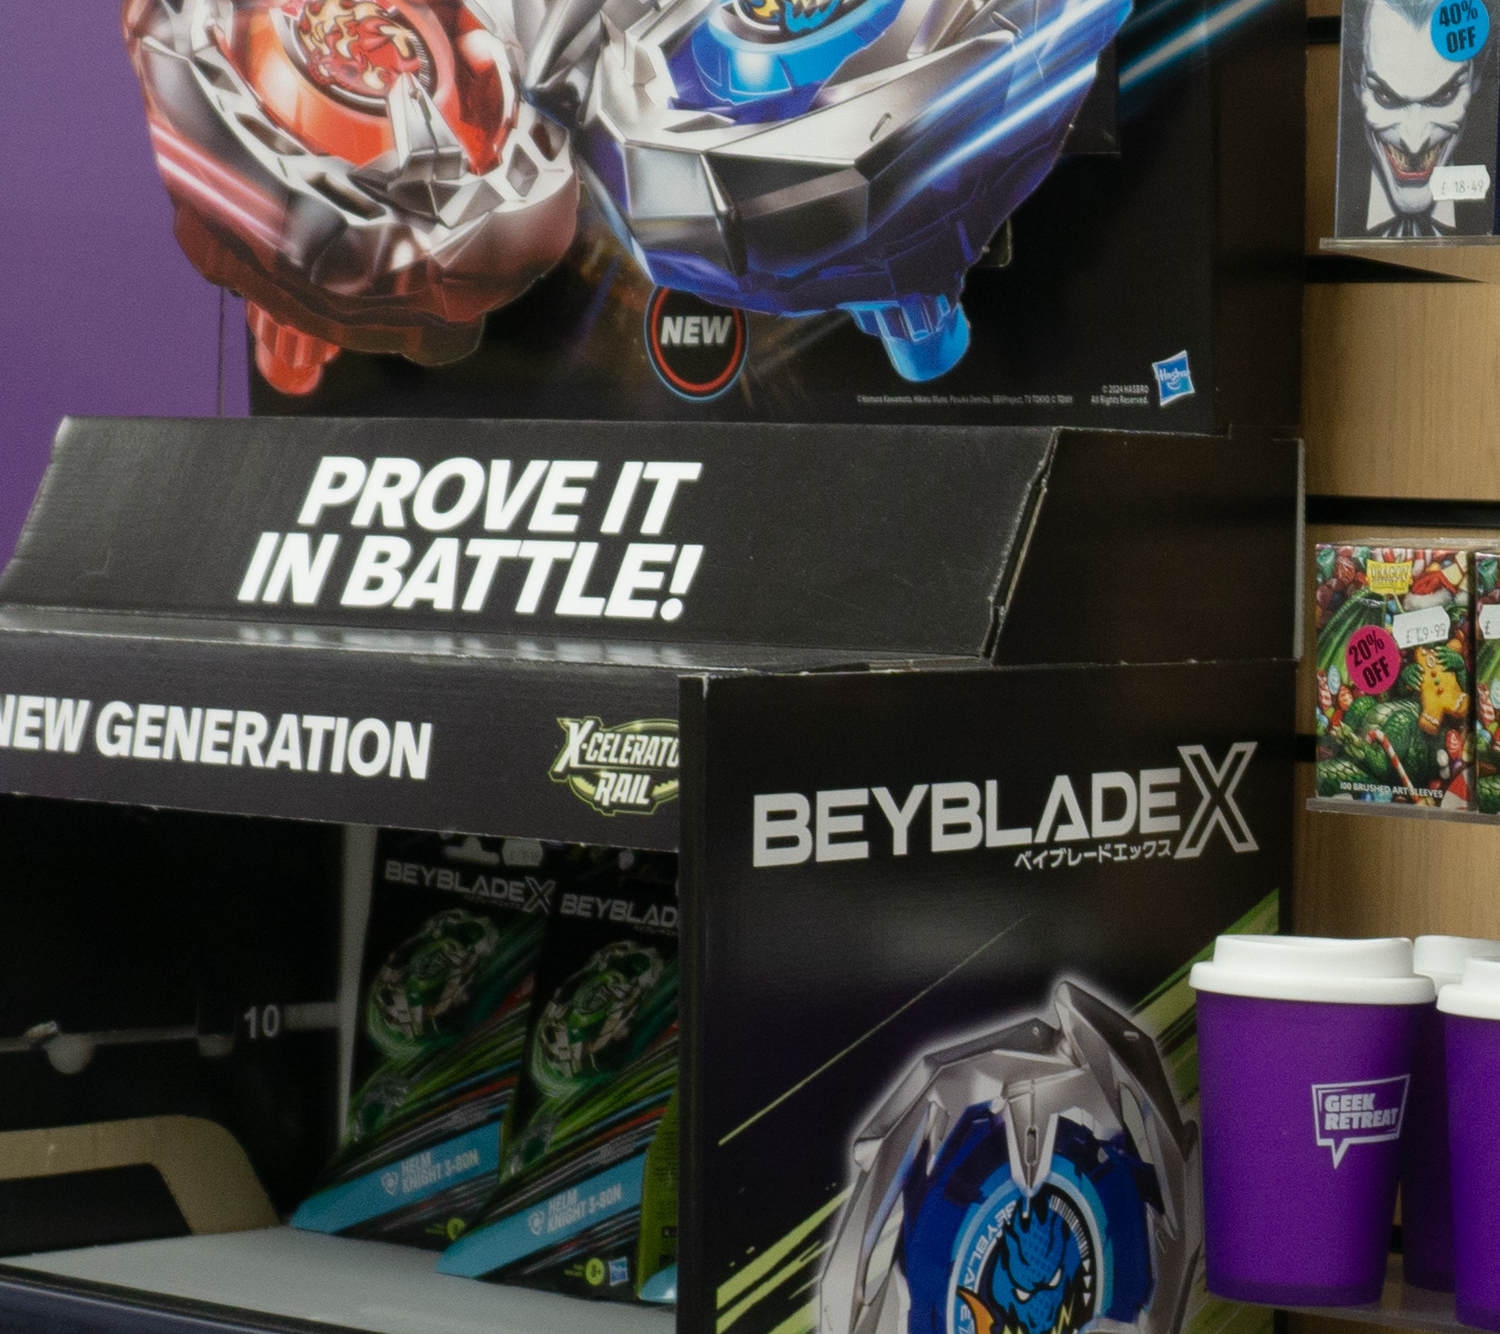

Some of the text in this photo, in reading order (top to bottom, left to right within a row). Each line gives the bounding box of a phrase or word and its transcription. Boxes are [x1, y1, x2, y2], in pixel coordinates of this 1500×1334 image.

[1437, 0, 1482, 32] 40%
[1444, 25, 1479, 53] OFF
[660, 316, 733, 346] NEW
[298, 455, 702, 536] PROVE IT
[237, 530, 704, 623] IN BATTLE!
[93, 701, 434, 781] GENERATION
[594, 770, 651, 807] RAIL
[243, 1004, 281, 1041] 10
